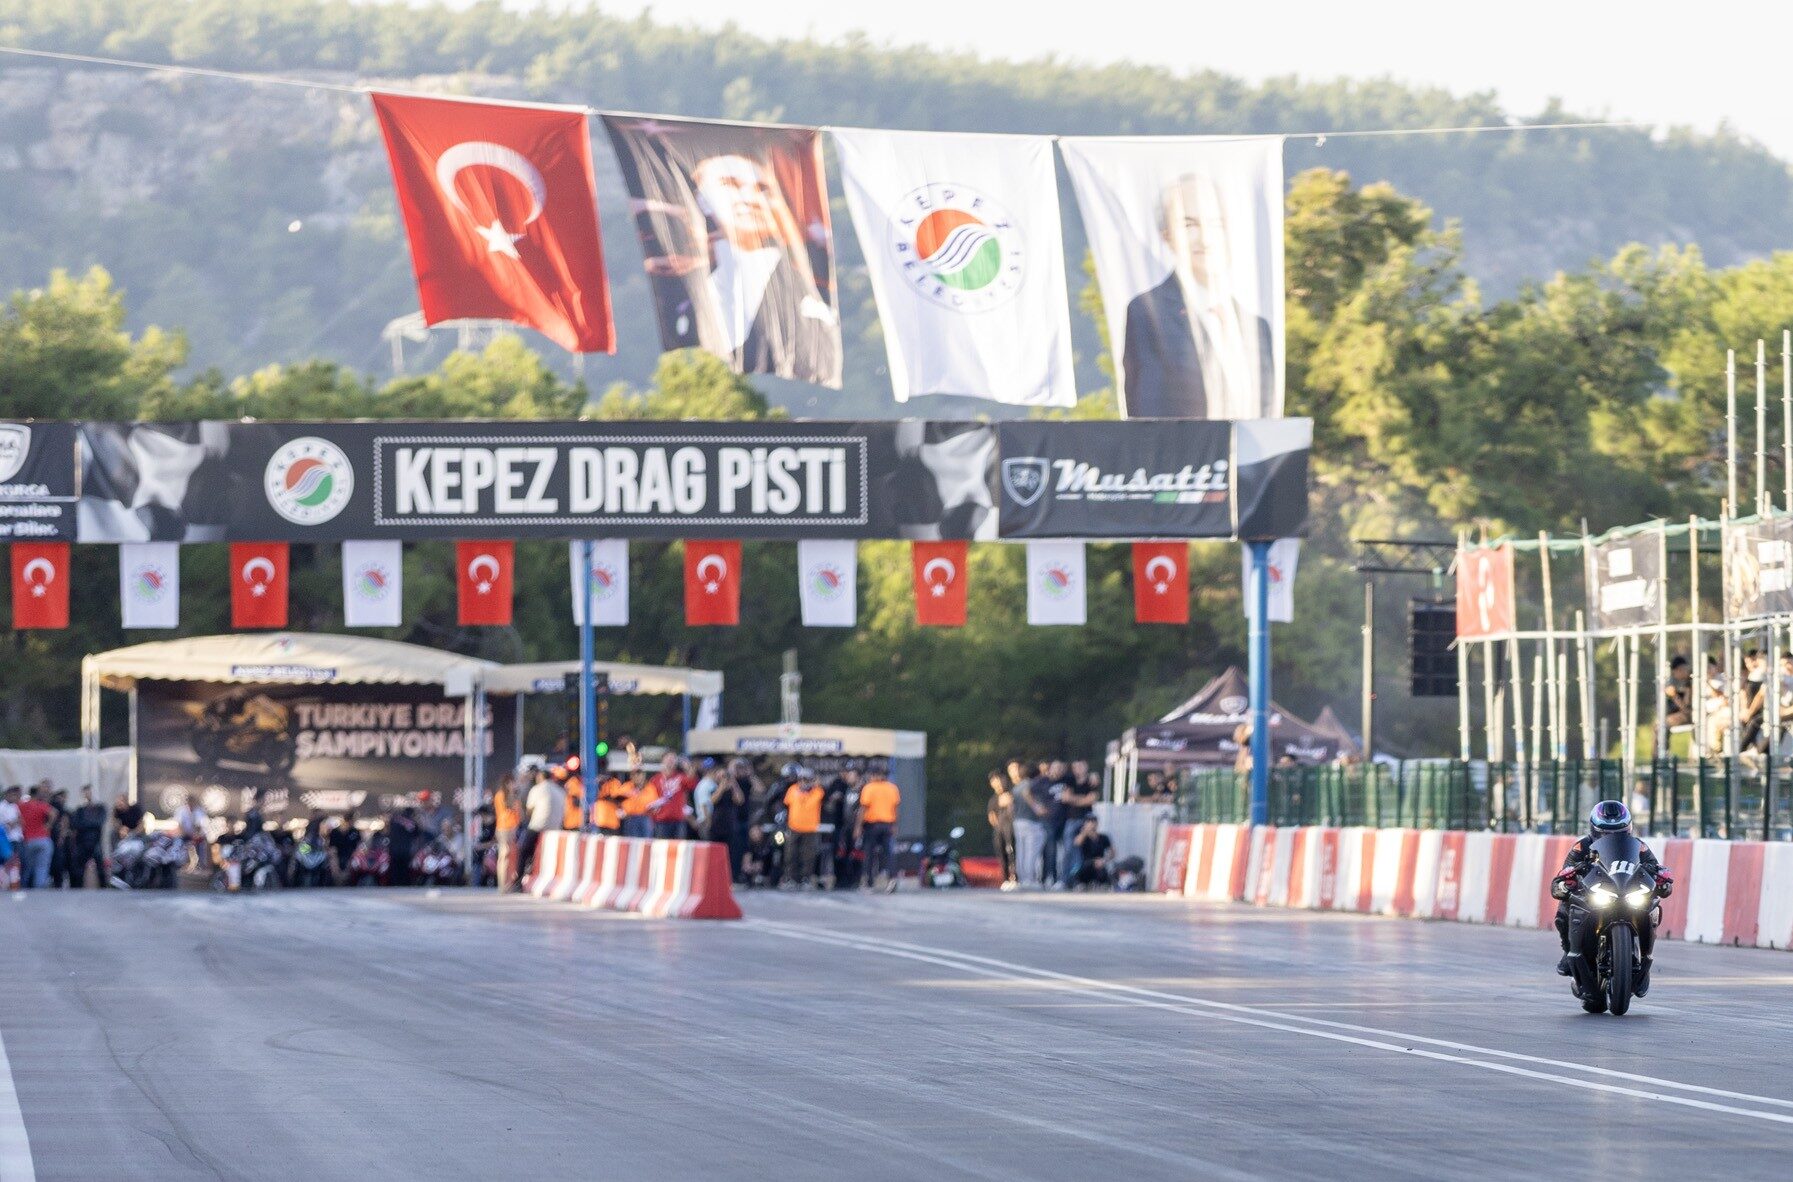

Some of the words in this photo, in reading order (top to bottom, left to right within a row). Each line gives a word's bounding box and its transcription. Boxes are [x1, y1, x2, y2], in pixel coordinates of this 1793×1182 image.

[395, 447, 558, 514] KEPEZ
[569, 447, 706, 514] DRAG
[1053, 459, 1229, 492] Musatti
